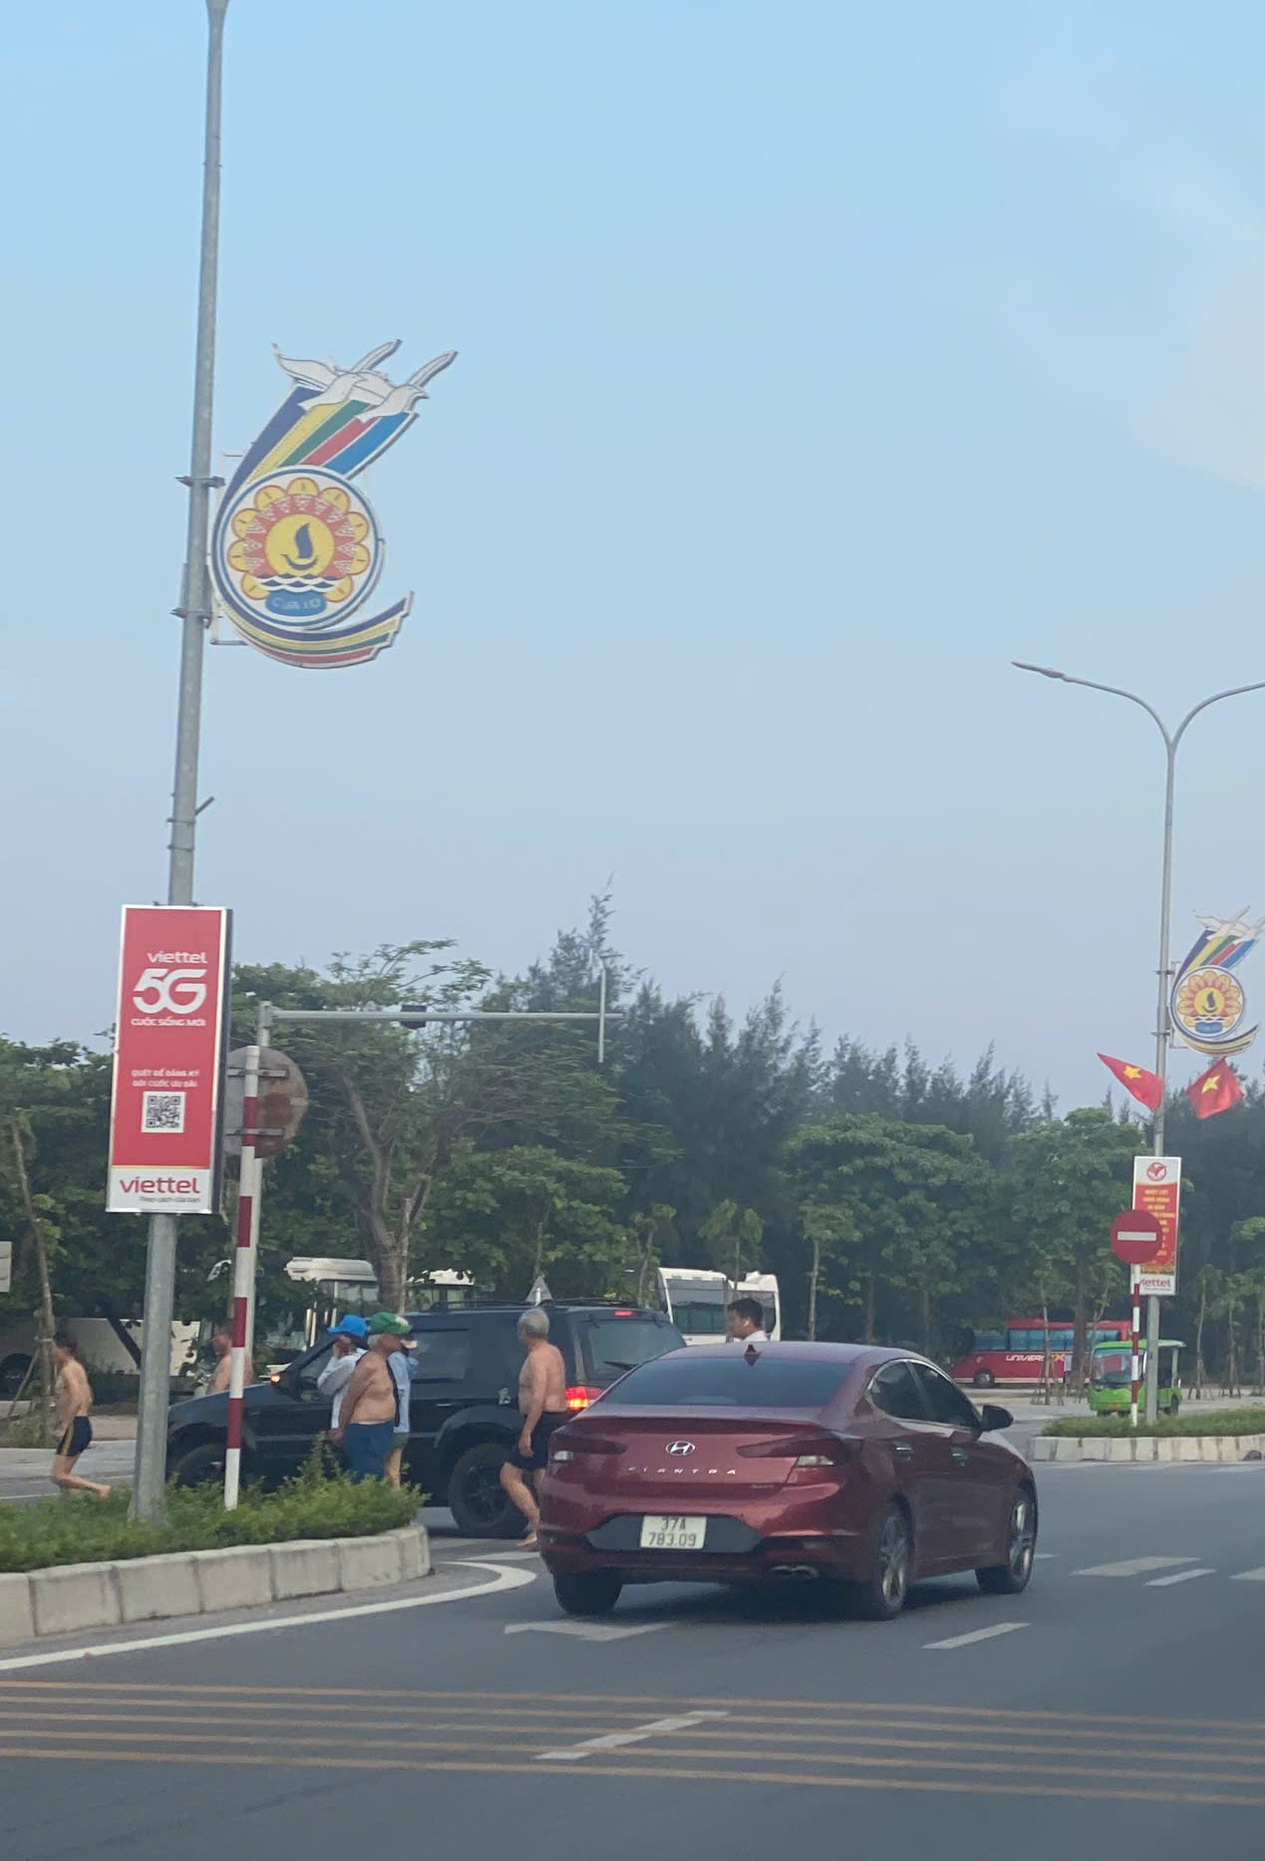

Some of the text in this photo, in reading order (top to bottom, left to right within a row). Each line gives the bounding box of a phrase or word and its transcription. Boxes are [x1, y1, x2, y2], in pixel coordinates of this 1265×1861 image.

[147, 951, 208, 964] viettel
[133, 968, 208, 1014] 5G
[120, 1176, 200, 1194] viettel
[661, 1516, 686, 1531] 37A
[648, 1532, 697, 1547] 783.09
